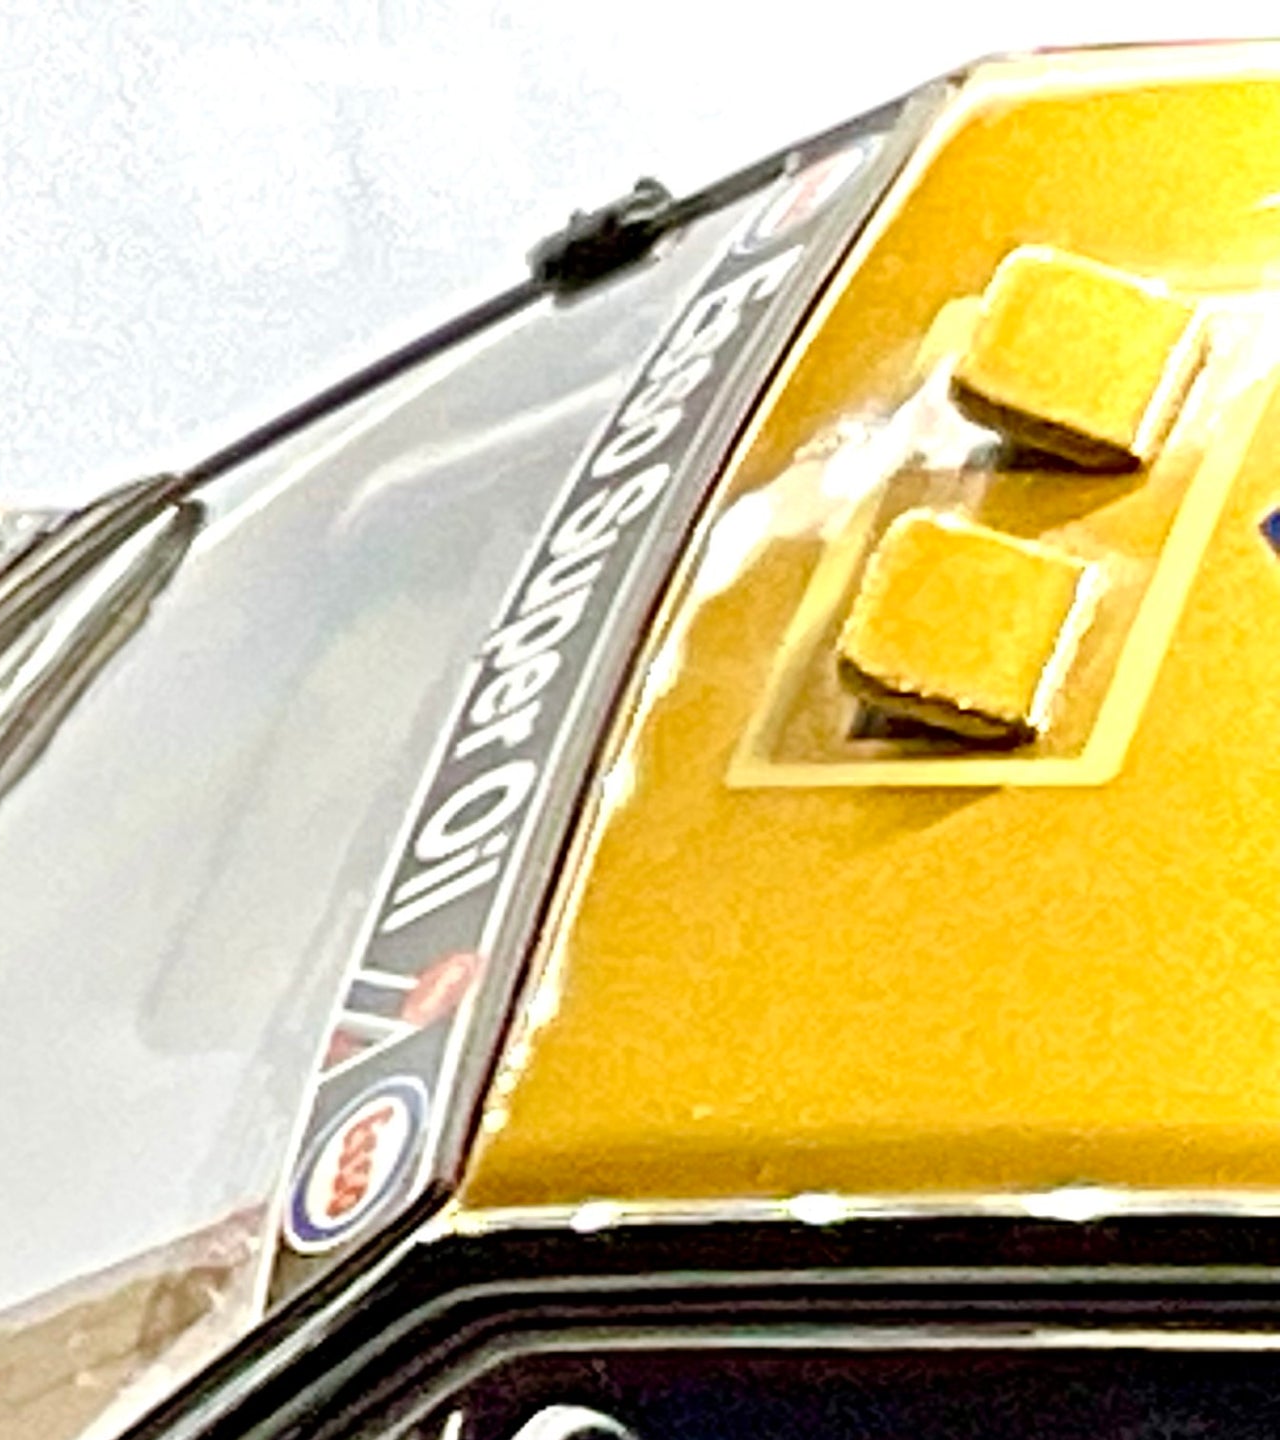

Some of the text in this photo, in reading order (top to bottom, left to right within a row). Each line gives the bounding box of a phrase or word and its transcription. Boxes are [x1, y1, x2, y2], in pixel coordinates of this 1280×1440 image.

[382, 243, 804, 933] Esso Super Oil
